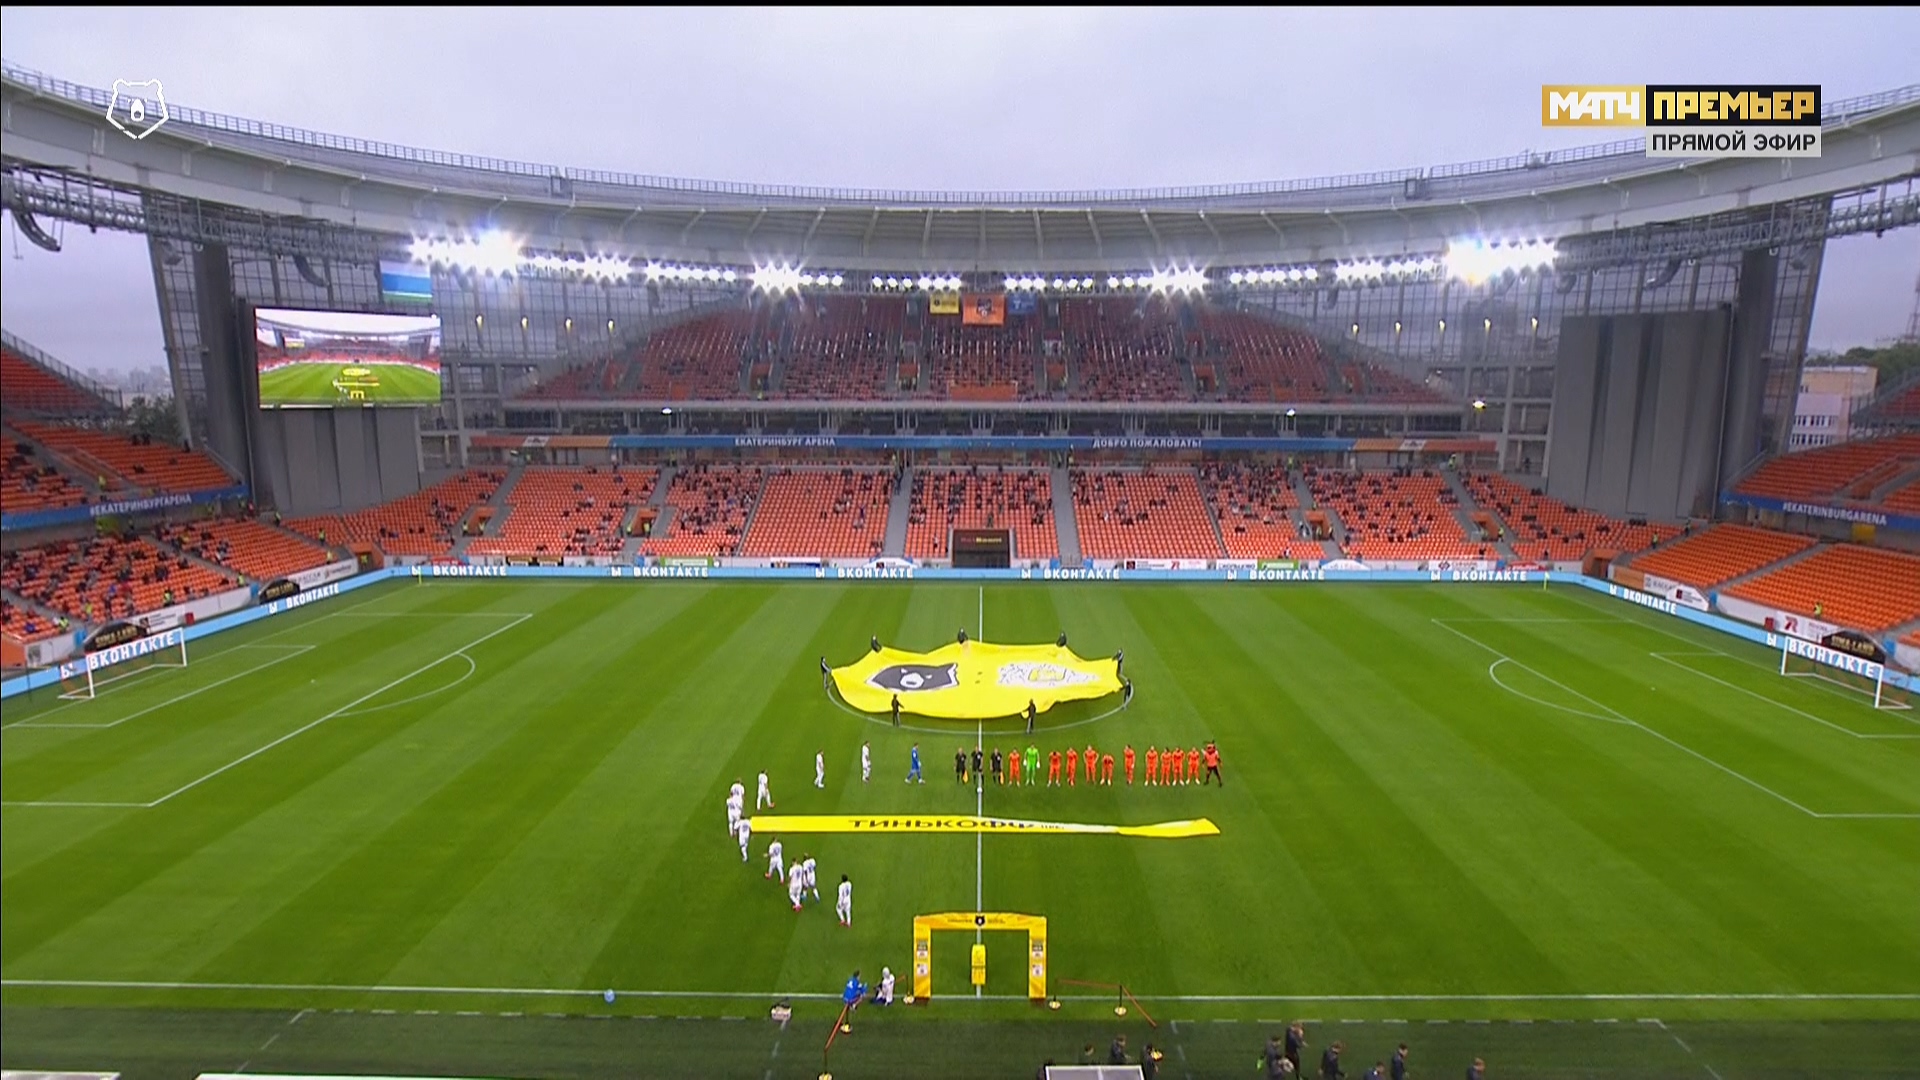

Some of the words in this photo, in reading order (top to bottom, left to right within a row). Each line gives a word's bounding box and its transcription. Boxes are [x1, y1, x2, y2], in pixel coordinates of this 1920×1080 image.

[735, 437, 801, 447] ЕКАТЕРИНБУРГ
[804, 437, 836, 447] АРЕНА
[1092, 438, 1127, 449] ДОБРО
[1782, 502, 1888, 526] #EKATERINBURGARENA
[433, 565, 507, 576] ВКОНТАКТЕ
[633, 566, 709, 577] ВКОНТАКТЕ
[837, 567, 914, 578] ВКОНТАКТЕ
[1044, 568, 1120, 579] ВКОНТАКТЕ
[1250, 569, 1325, 580] ВКОНТАКТЕ
[1452, 571, 1528, 581] ВКОНТАКТЕ
[286, 582, 340, 609] ВКОНТАКТЕ
[1623, 588, 1677, 615] ВКОНТАКТЕ
[89, 632, 175, 671] ВКОНТАКТЕ
[1788, 638, 1876, 678] ВКОНТАКТЕ
